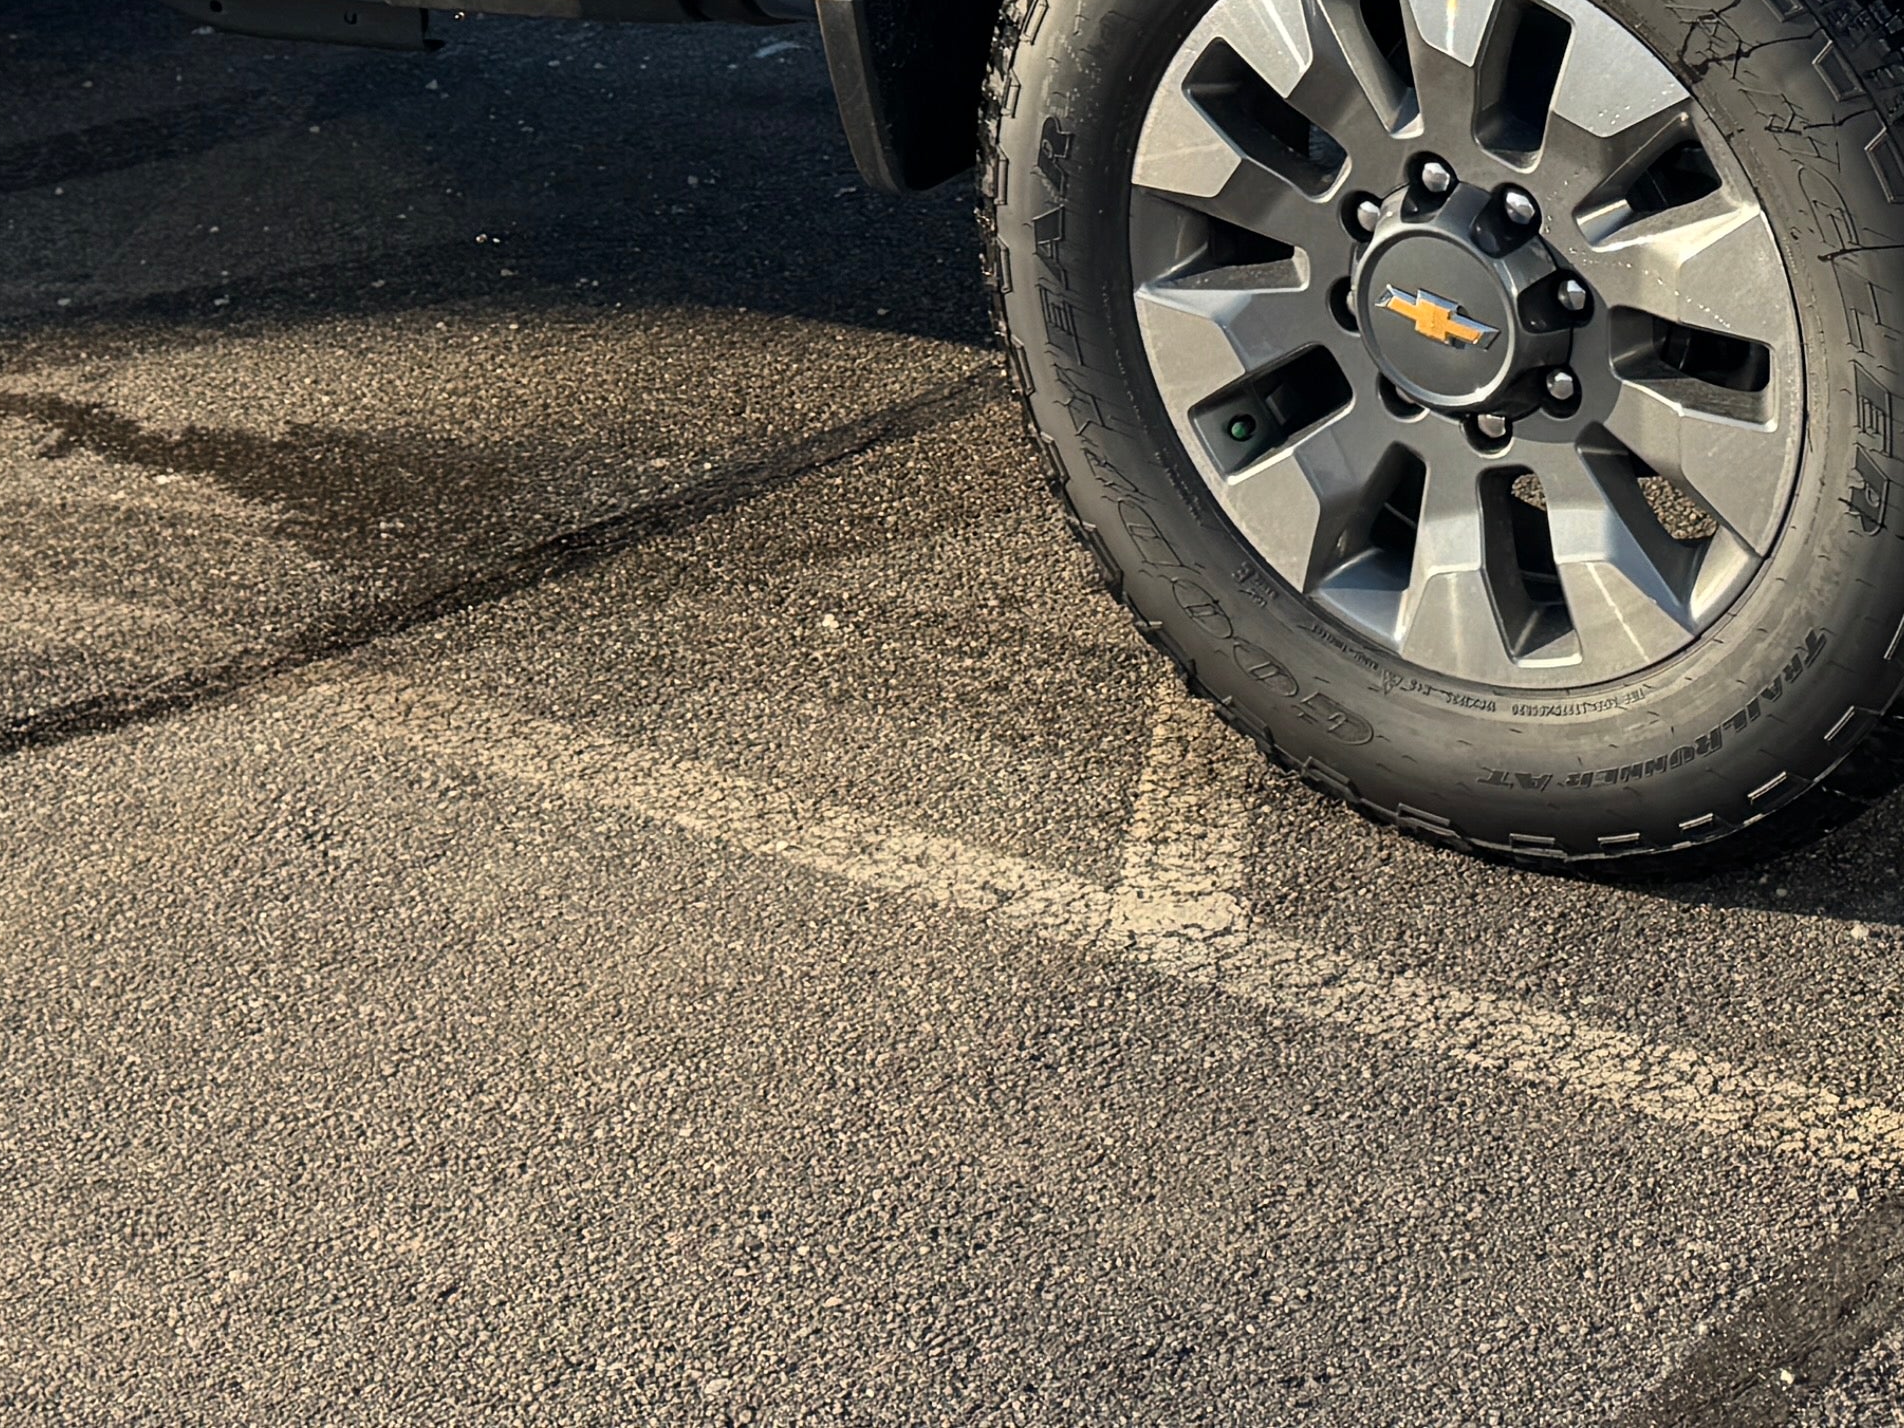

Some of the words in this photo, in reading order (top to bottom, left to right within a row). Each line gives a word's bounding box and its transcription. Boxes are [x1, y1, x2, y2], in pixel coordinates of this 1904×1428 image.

[1030, 114, 1376, 746] GOODYEAR
[1476, 767, 1554, 793] AT
[1564, 626, 1830, 789] TRAILRUNNER
